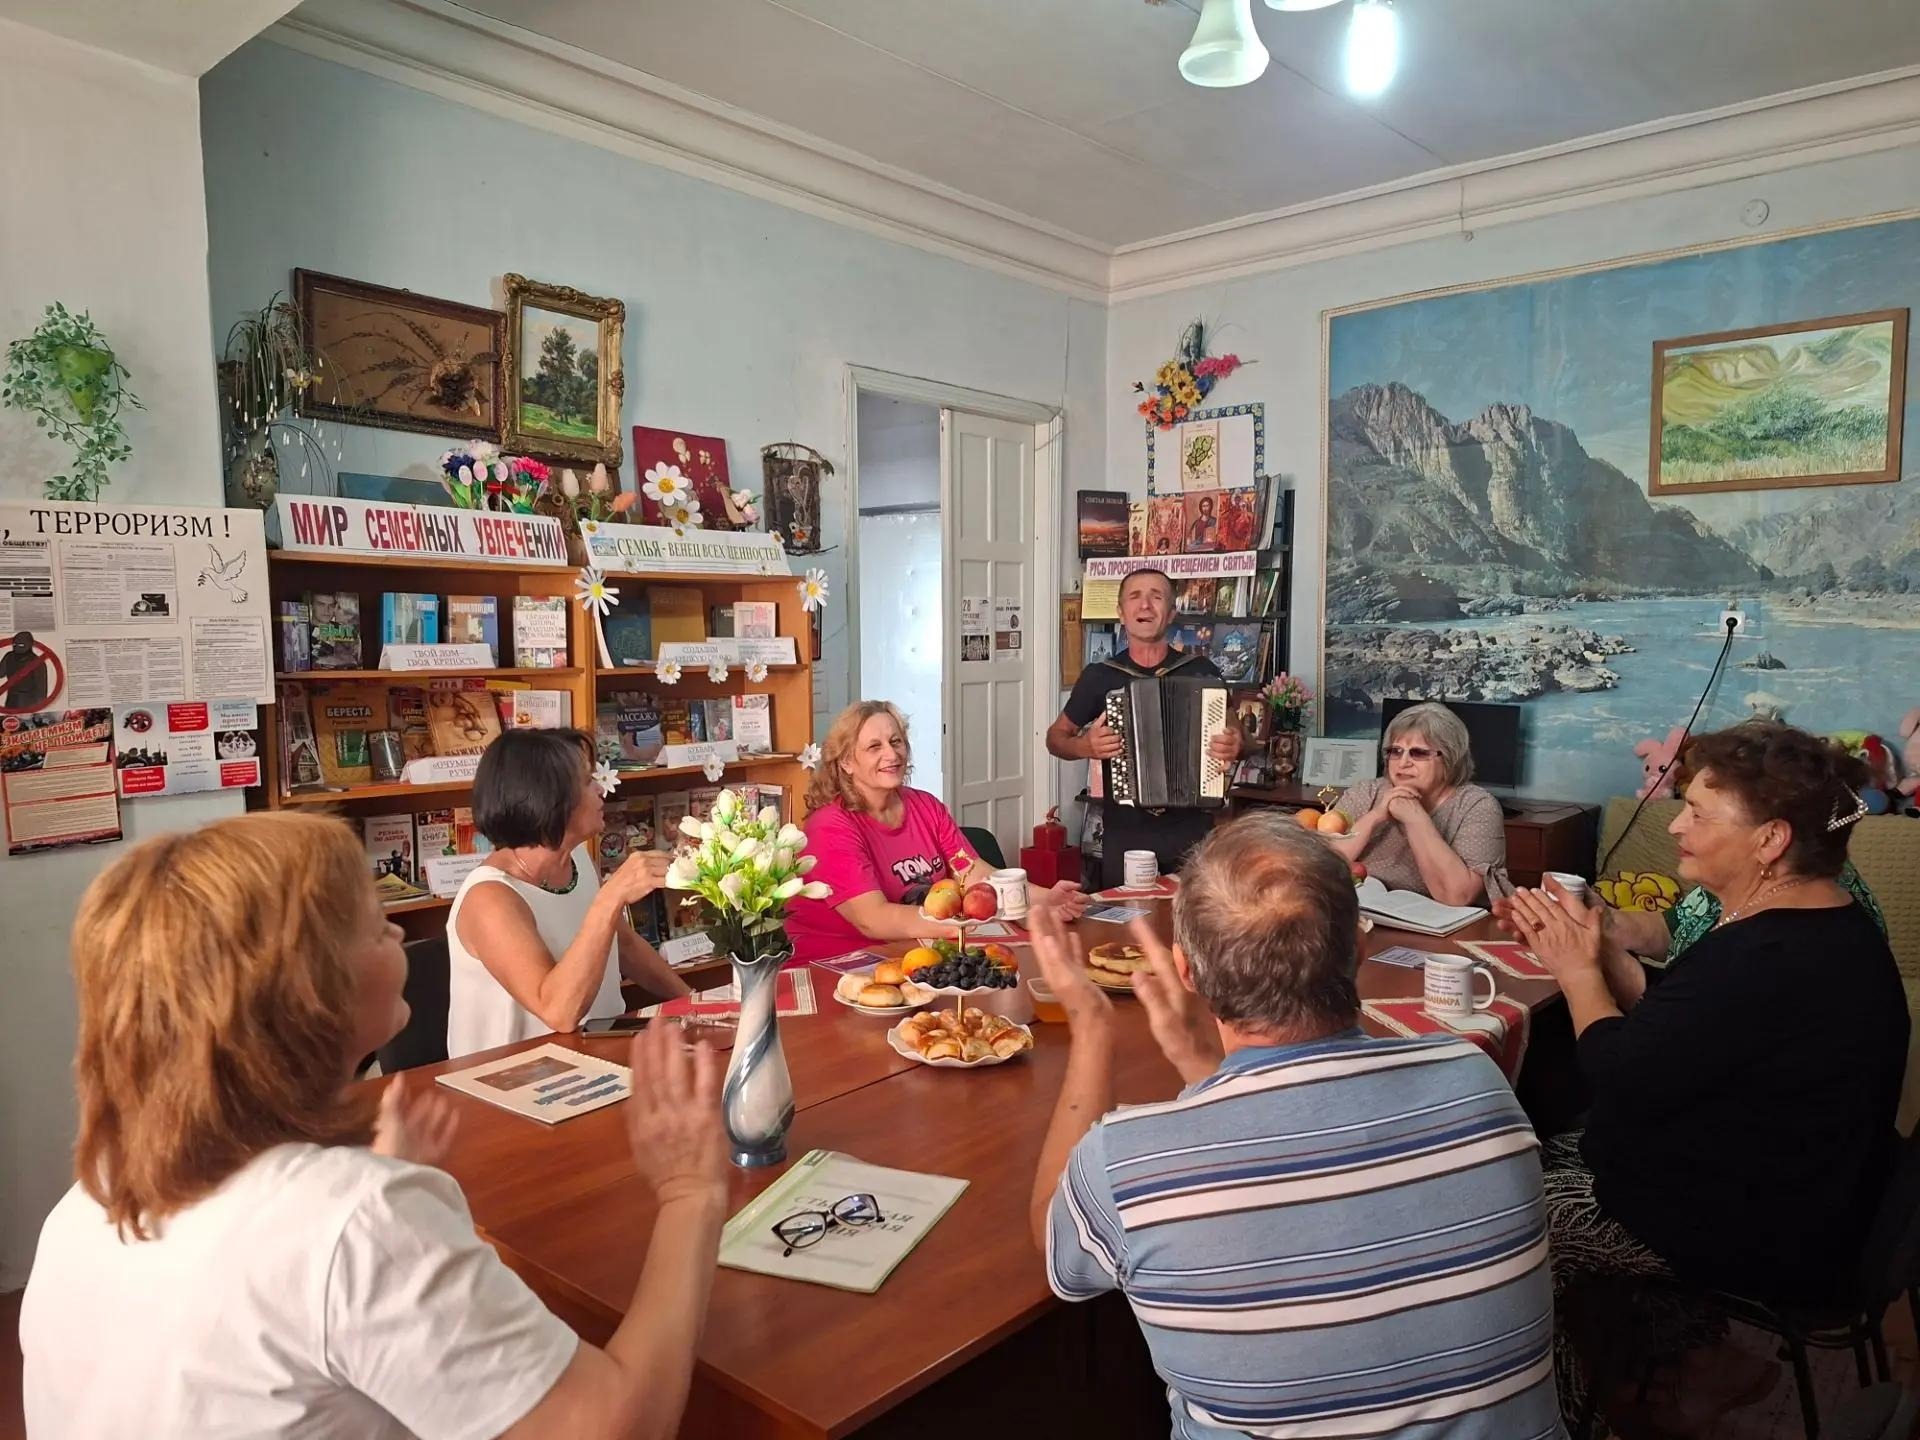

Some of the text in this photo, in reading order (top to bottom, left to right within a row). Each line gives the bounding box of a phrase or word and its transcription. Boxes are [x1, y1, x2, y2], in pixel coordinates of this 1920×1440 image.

[290, 502, 567, 560] МИР СЕМЕЙНЫХ УВЛЕЧЕНИЙ
[617, 537, 662, 559] СЕМЬЯ
[668, 541, 703, 560] ВЕНЕЦ
[703, 544, 726, 559] ВСЕХ
[727, 543, 782, 561] ЦЕННОСТЕЙ
[1089, 562, 1107, 577] РУСЬ
[1171, 556, 1220, 576] КРЕЩЕНИЕМ
[414, 649, 437, 658] ТВОЙ
[406, 657, 479, 667] ТВОЯ КРЕПОСТЬ
[327, 707, 372, 717] БЕРЕСТА
[617, 711, 658, 722] МАССАЖА
[2, 720, 83, 747] ЭКСТРЕМИЗМ
[34, 741, 48, 753] НЕ
[422, 833, 448, 841] КНИГА
[892, 855, 932, 882] TOM
